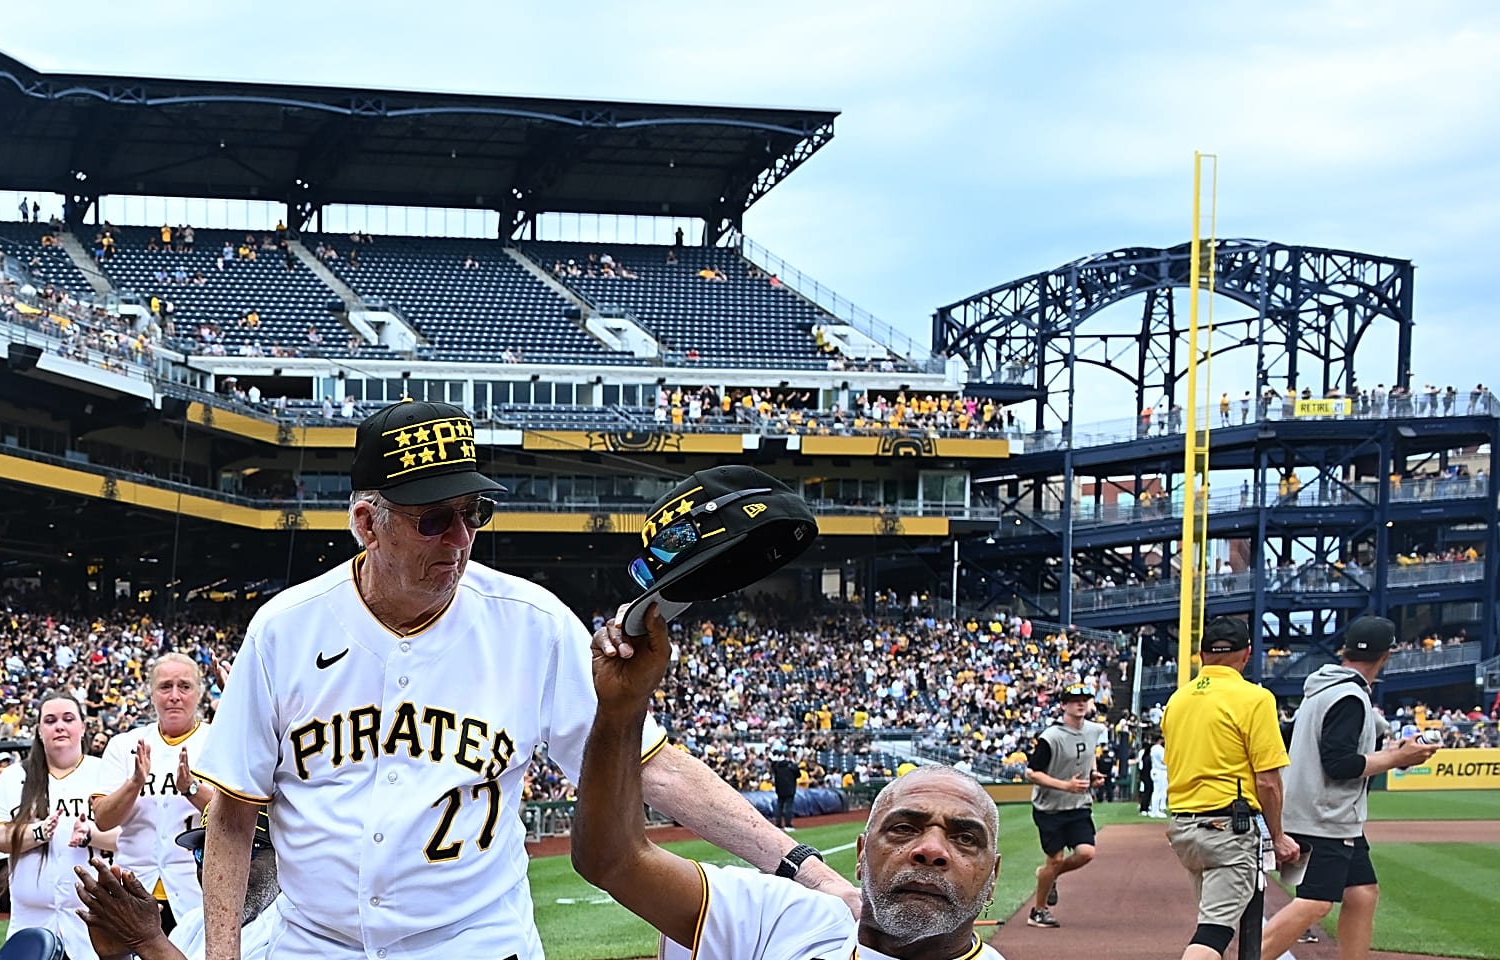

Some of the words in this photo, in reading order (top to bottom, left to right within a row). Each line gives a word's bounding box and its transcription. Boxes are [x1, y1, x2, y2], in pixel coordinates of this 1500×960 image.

[289, 701, 517, 782] PIRATES
[1435, 762, 1456, 776] PA
[422, 779, 503, 864] 27
